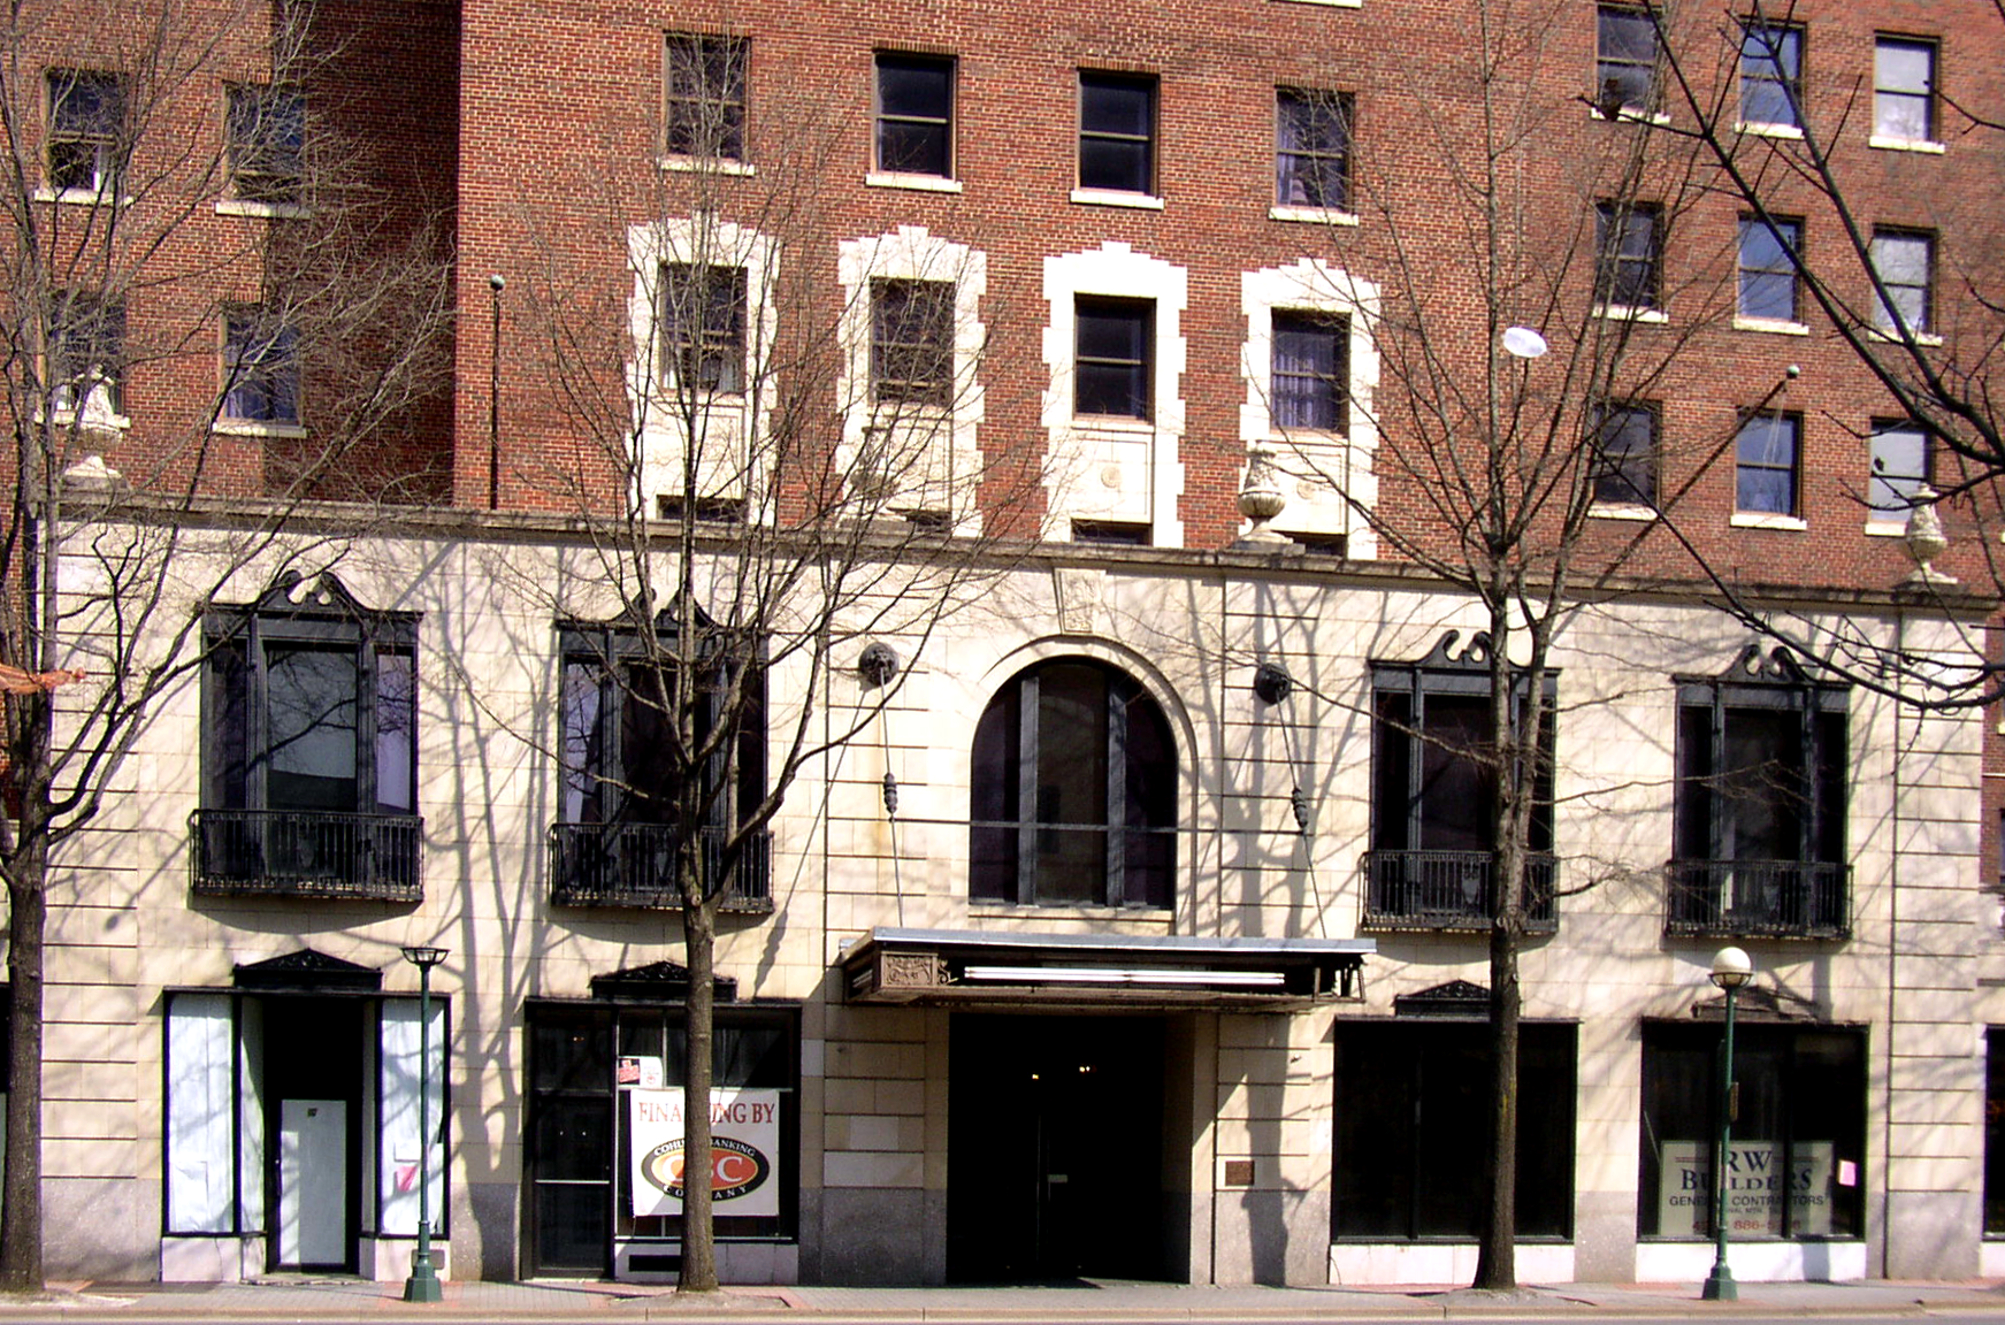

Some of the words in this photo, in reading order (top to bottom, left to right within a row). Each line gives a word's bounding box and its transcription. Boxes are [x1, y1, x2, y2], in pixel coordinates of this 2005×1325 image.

[638, 1102, 747, 1123] FINAING
[752, 1103, 775, 1124] BY
[710, 1138, 756, 1157] ANKING
[662, 1155, 743, 1183] CC
[663, 1184, 747, 1200] COANY
[1731, 1195, 1824, 1206] CONTRATORS
